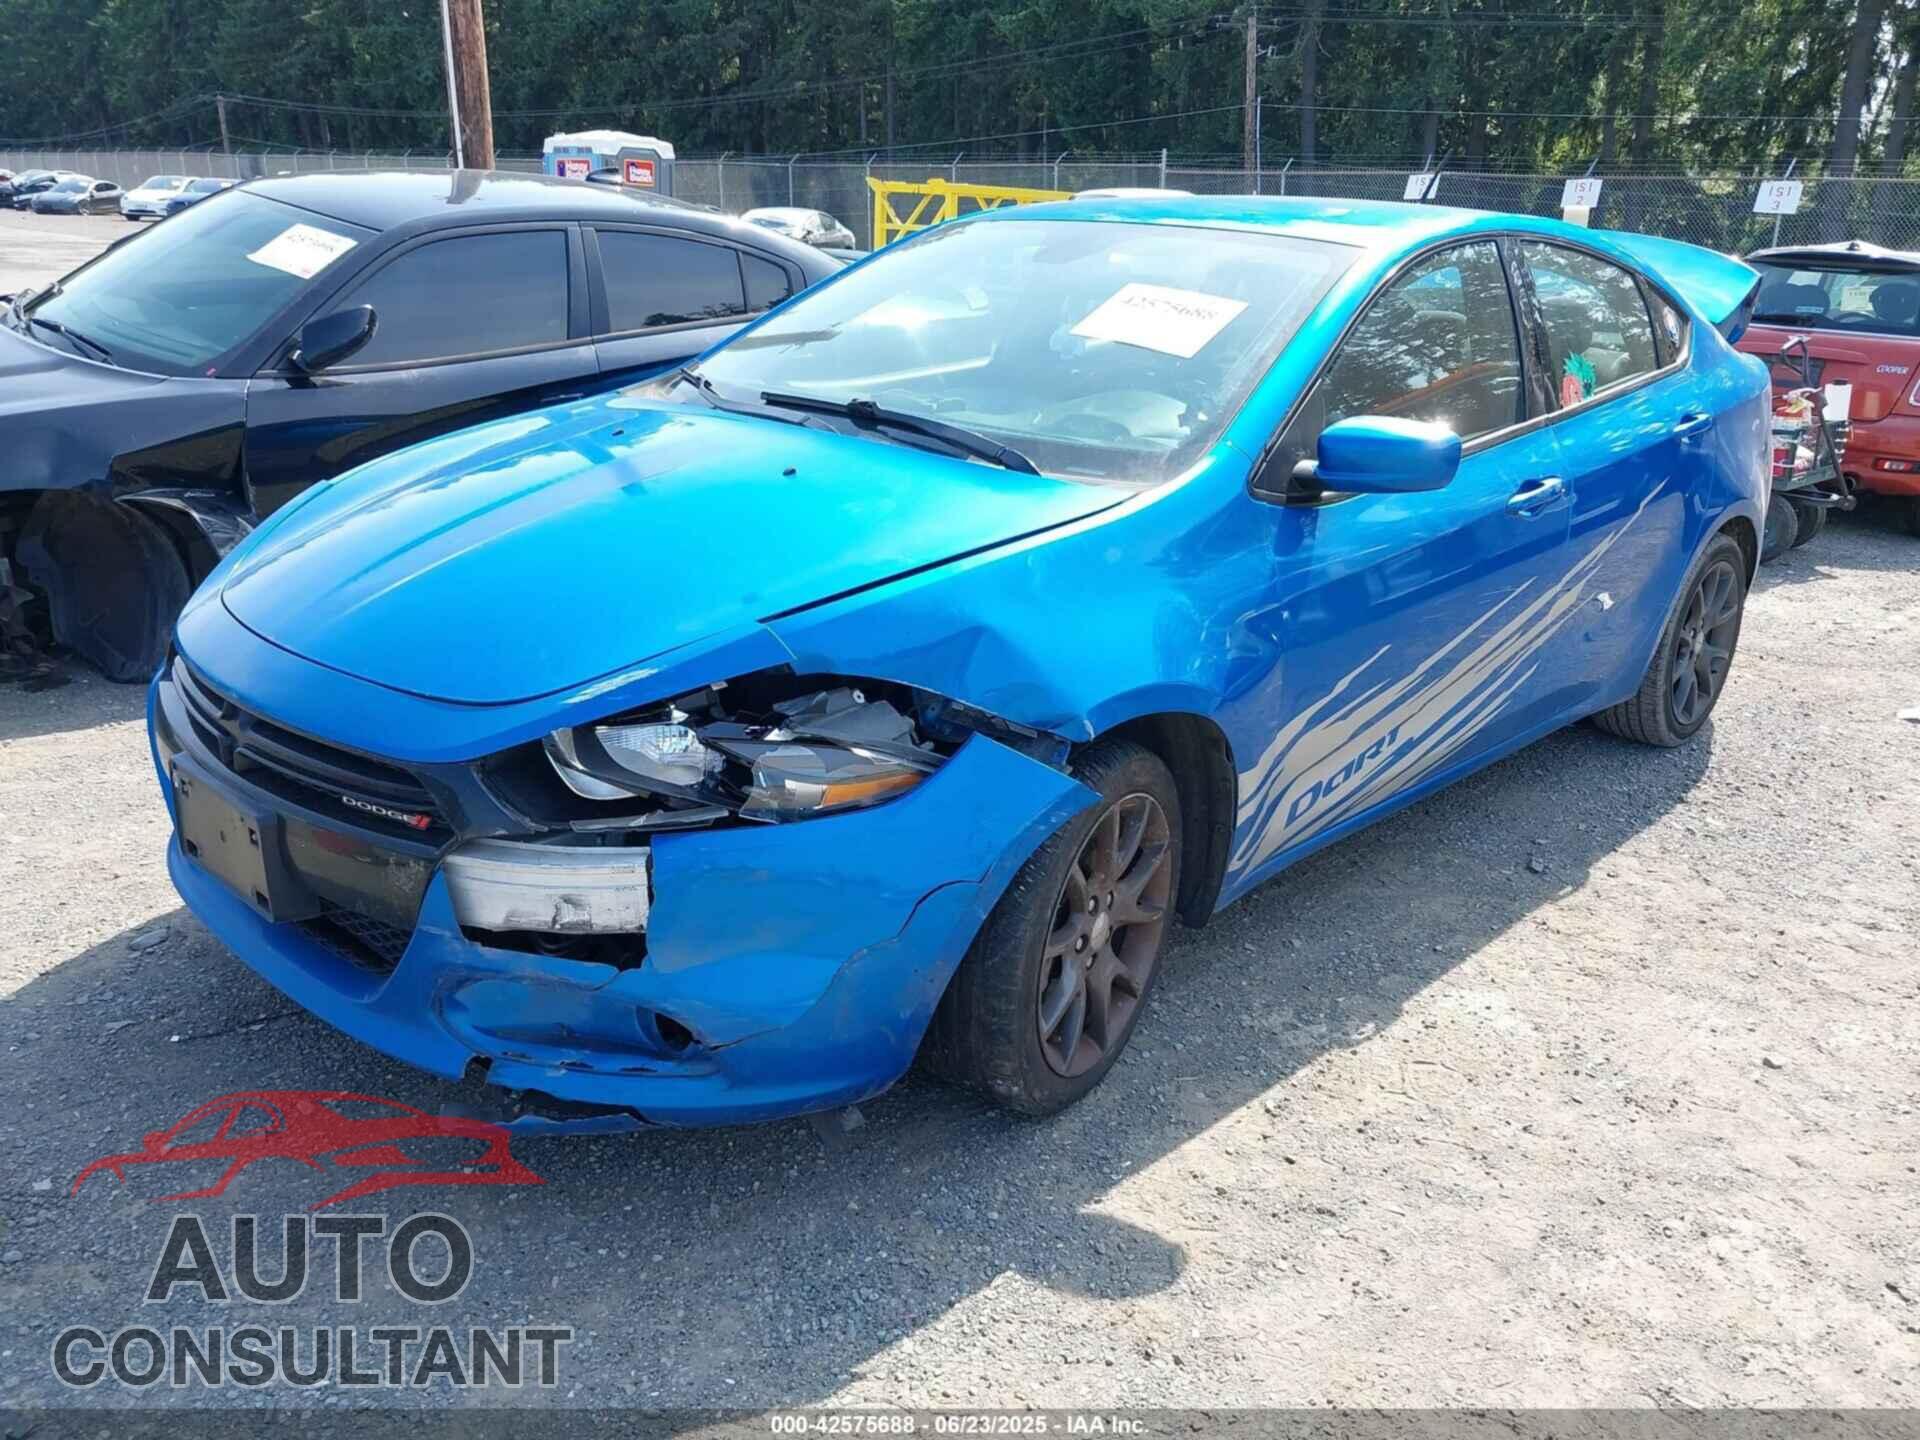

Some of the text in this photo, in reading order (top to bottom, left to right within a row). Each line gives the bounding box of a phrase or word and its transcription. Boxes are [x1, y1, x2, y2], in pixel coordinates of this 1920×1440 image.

[1575, 195, 1584, 205] 2
[1770, 199, 1781, 210] 3
[1876, 364, 1909, 376] COOPER
[342, 796, 417, 825] DODGE
